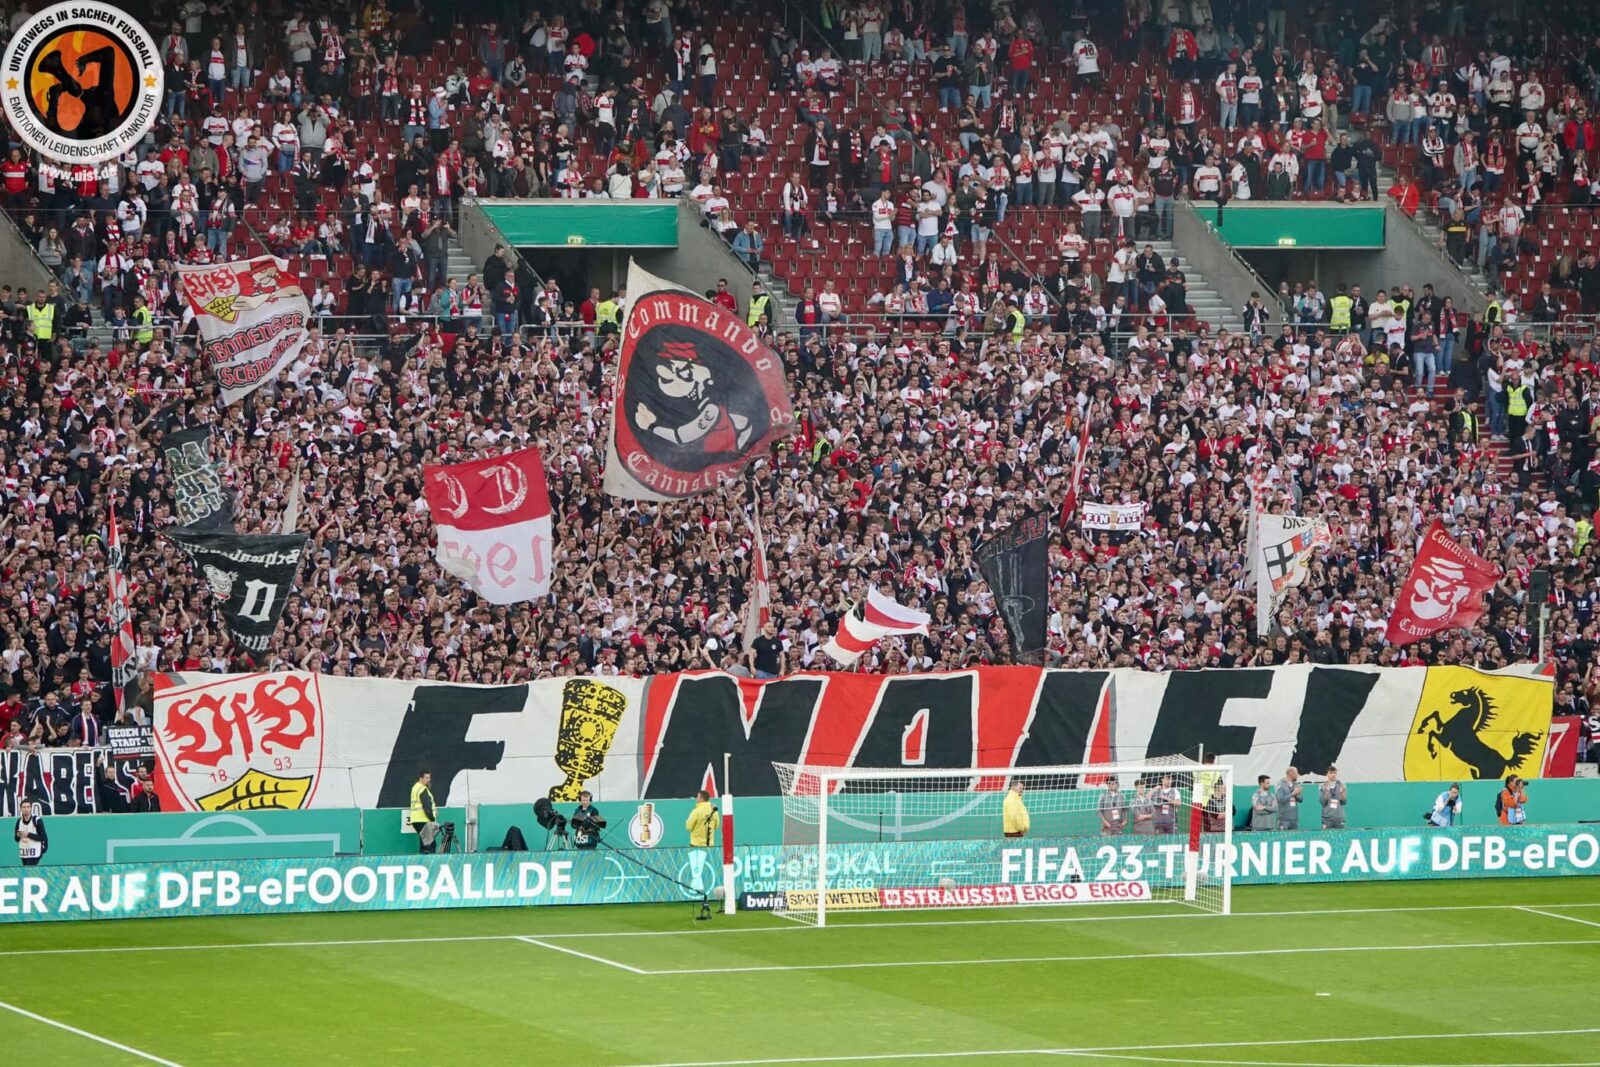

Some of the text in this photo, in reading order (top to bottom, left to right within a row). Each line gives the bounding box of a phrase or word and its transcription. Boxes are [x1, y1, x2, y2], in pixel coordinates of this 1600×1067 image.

[108, 727, 139, 738] GEGEN
[274, 756, 293, 770] 93
[209, 769, 228, 783] 18
[1002, 833, 1600, 882] FIFA 23-TURNIER AUF DFB-eFO
[58, 873, 147, 912] AUF
[159, 861, 573, 909] DFB-eFOOTBALL.DE
[744, 879, 812, 893] POWERED
[837, 878, 874, 890] ERGO
[1022, 884, 1077, 900] ERGO
[1089, 881, 1144, 899] ERGO
[746, 894, 784, 908] bwin
[903, 886, 994, 905] STRAUSS
